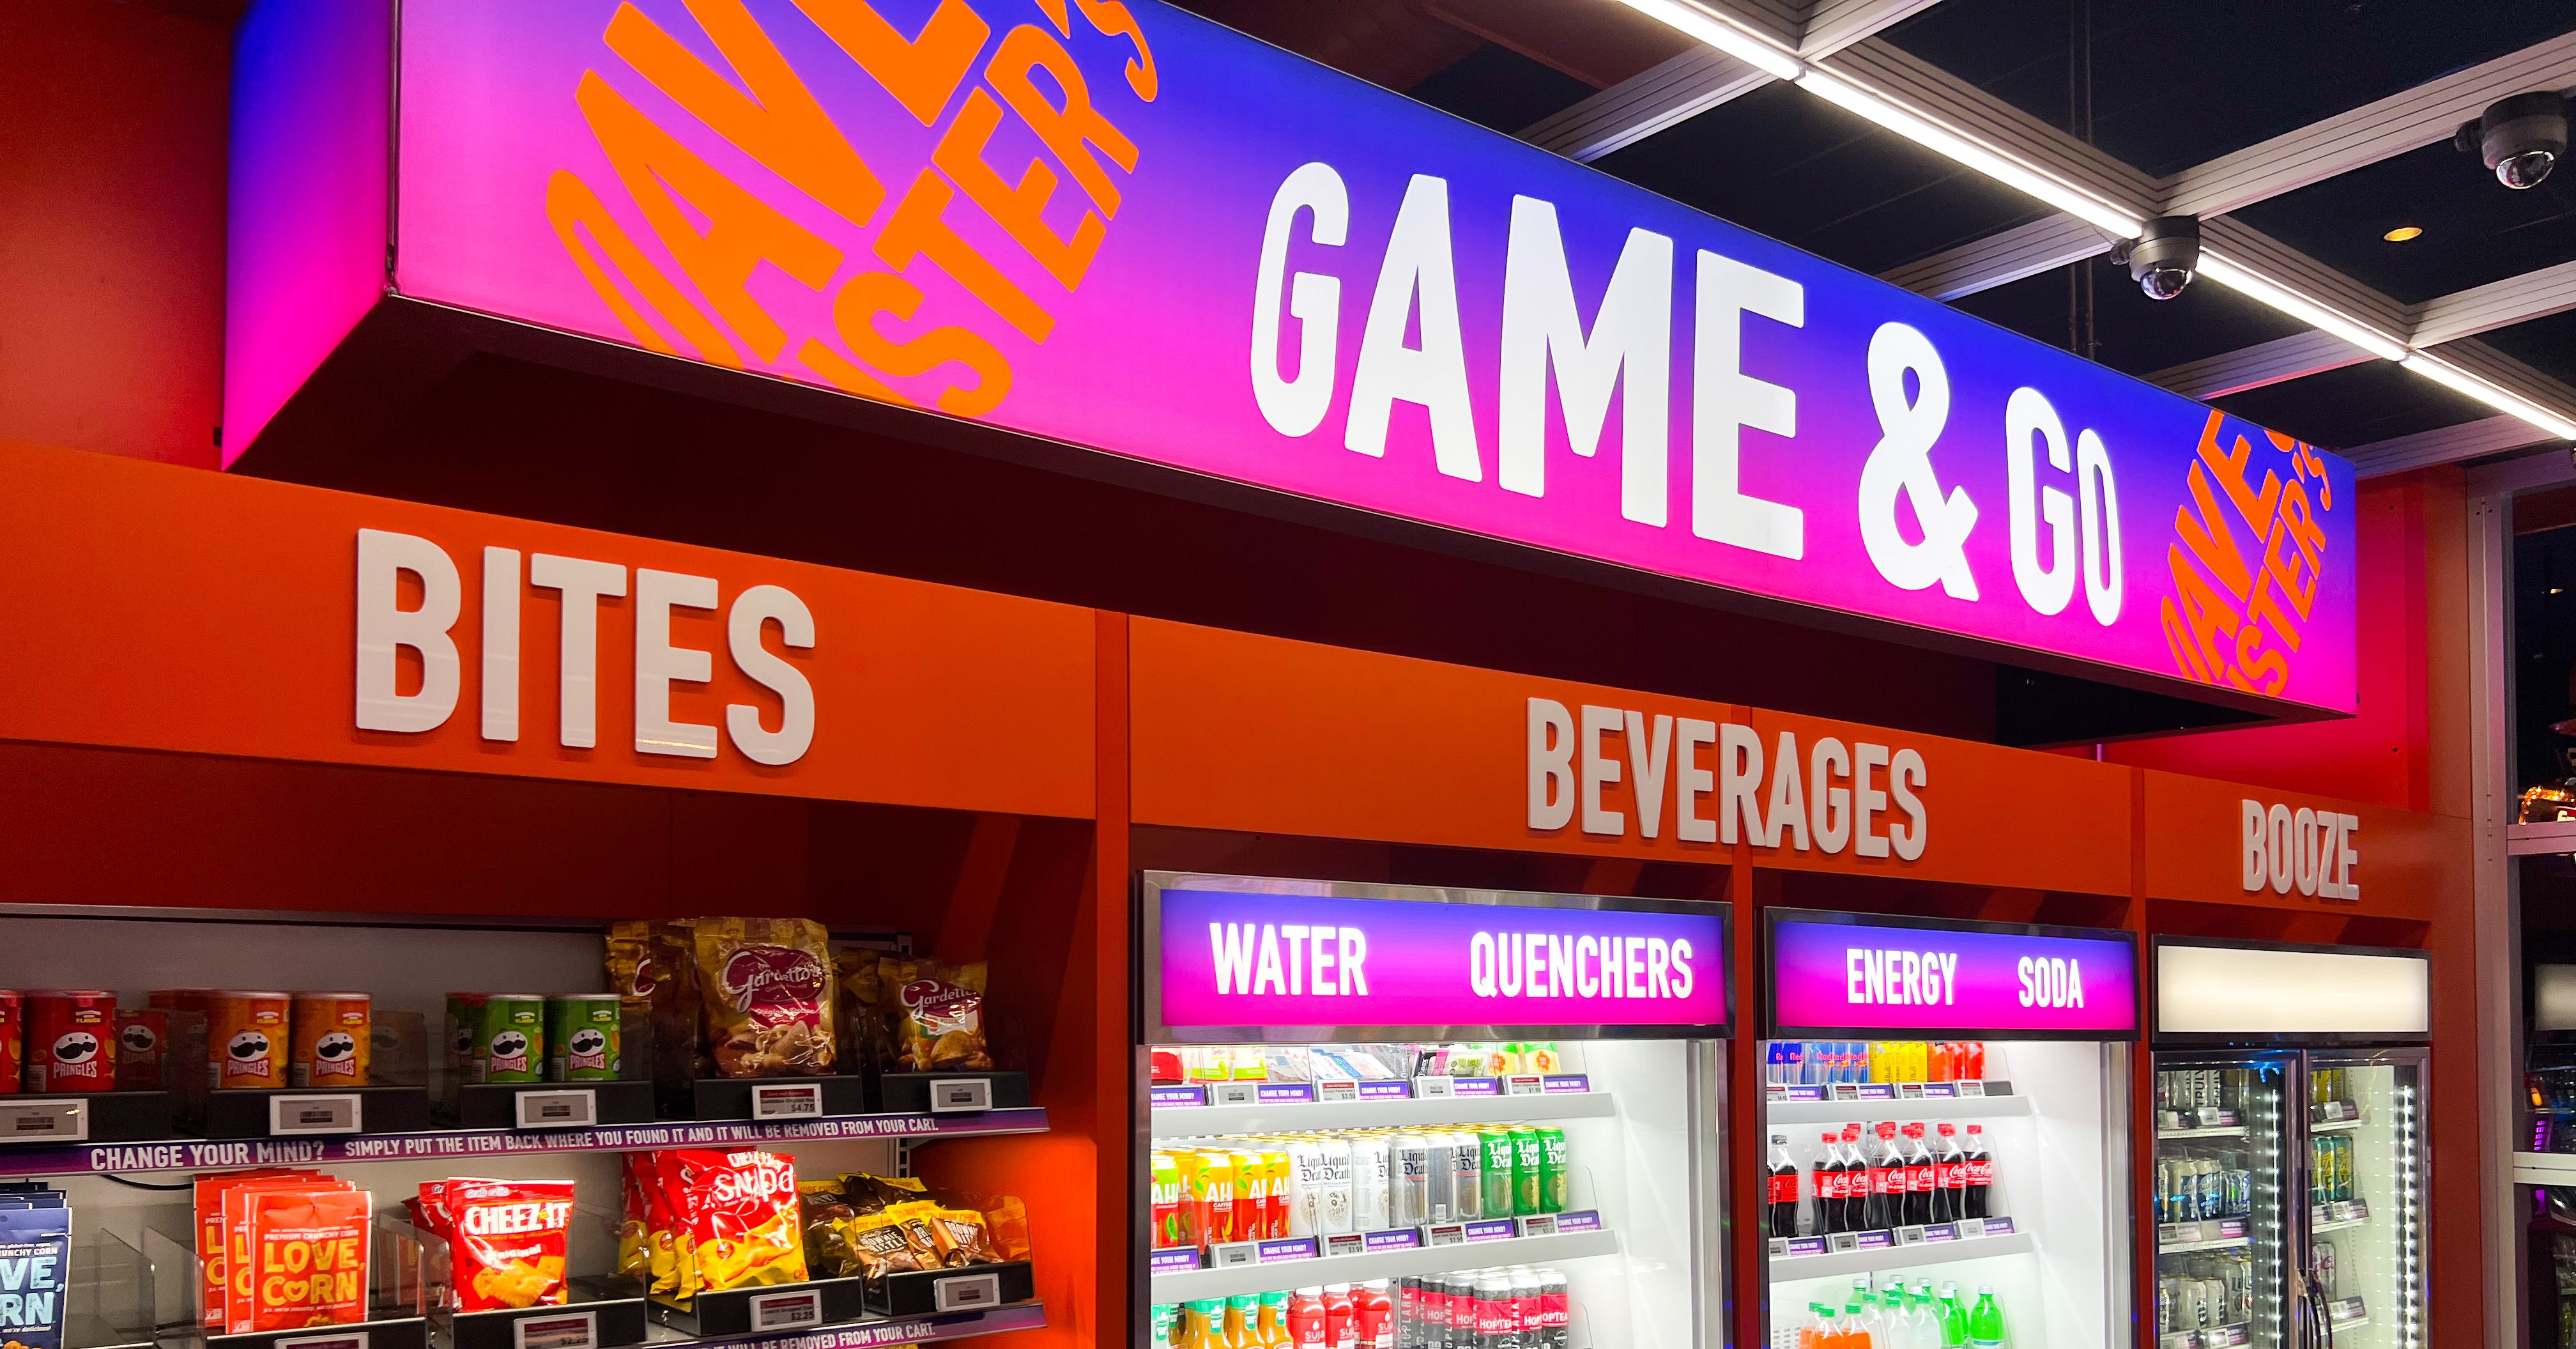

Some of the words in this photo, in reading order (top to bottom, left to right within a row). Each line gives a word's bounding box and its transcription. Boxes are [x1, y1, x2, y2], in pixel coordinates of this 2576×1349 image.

[1250, 162, 1804, 561] GAME
[1858, 321, 1979, 602] &
[2005, 387, 2122, 626] GO
[355, 528, 815, 765] BITES
[1528, 697, 1926, 861] BEVERAGES
[2242, 799, 2359, 900] BOOZE
[1209, 923, 1368, 996] WATER
[1470, 932, 1694, 999] QUENCHERS
[1846, 948, 1958, 1006] ENERGY
[2018, 957, 2084, 1008] SODA
[54, 1061, 97, 1079] PRINGLES
[227, 1059, 269, 1077] PRINGLES
[316, 1059, 355, 1077] PRINGLES
[491, 1056, 527, 1072] PRINGLES
[570, 1054, 605, 1070] PRINGLES
[791, 1104, 815, 1112] $4.75
[345, 1139, 400, 1157] SIMPLY
[406, 1137, 433, 1155] PUT
[436, 1137, 464, 1153] THE
[467, 1136, 500, 1152] ITEM
[505, 1134, 541, 1150] BACK
[544, 1132, 594, 1149] WHERE
[595, 1130, 622, 1146] YOU
[627, 1128, 668, 1145] FOUND
[673, 1127, 685, 1143] IT
[688, 1126, 713, 1142] AND
[716, 1125, 728, 1141] IT
[731, 1125, 762, 1140] WILL
[765, 1124, 781, 1139] BE
[784, 1121, 839, 1138] REMOVED
[841, 1120, 874, 1135] FROM
[875, 1118, 907, 1133] YOUR
[91, 1146, 183, 1170] CHANGE
[190, 1143, 250, 1166] YOUR
[257, 1141, 325, 1163] MIND?
[1320, 1153, 1350, 1169] Liquid
[1400, 1149, 1427, 1165] Liquid
[1324, 1167, 1351, 1180] Death
[1404, 1162, 1429, 1175] Death
[466, 1203, 570, 1235] CHEEZ-IT
[303, 1231, 339, 1240] CRUNCHY
[263, 1270, 358, 1306] CORN
[1445, 1300, 1453, 1349] OPLARK
[1542, 1312, 1568, 1322] OPTEA
[839, 1330, 871, 1347] FROM
[873, 1327, 903, 1343] YOUR
[1305, 1330, 1324, 1342] suja
